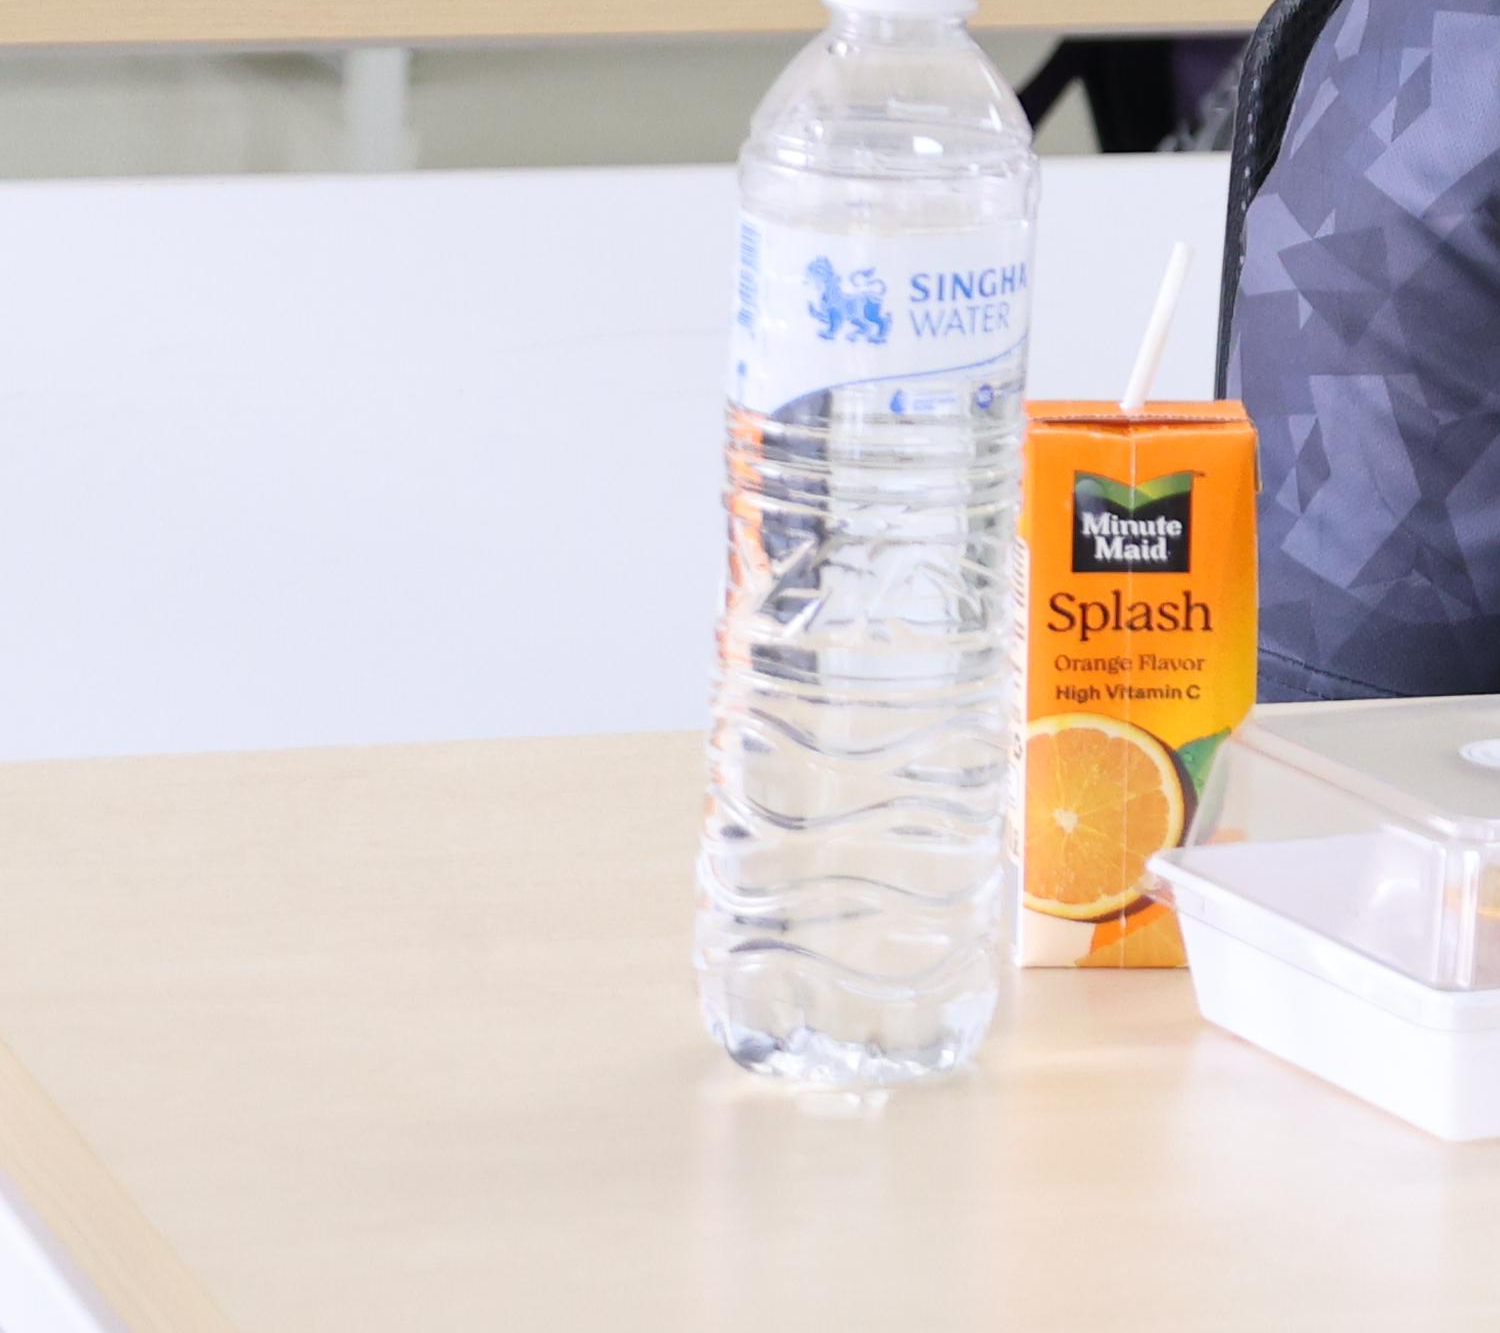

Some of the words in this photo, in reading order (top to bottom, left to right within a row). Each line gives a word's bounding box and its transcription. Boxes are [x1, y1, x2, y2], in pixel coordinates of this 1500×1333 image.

[909, 301, 1010, 337] WATER
[1081, 511, 1183, 537] Minute
[1094, 535, 1168, 561] Maid
[1047, 589, 1213, 642] Splash
[1054, 654, 1132, 674] Orange
[1138, 653, 1205, 672] Flavor
[1056, 685, 1100, 703] High
[1106, 684, 1182, 700] Vitamin
[1186, 684, 1201, 700] C
